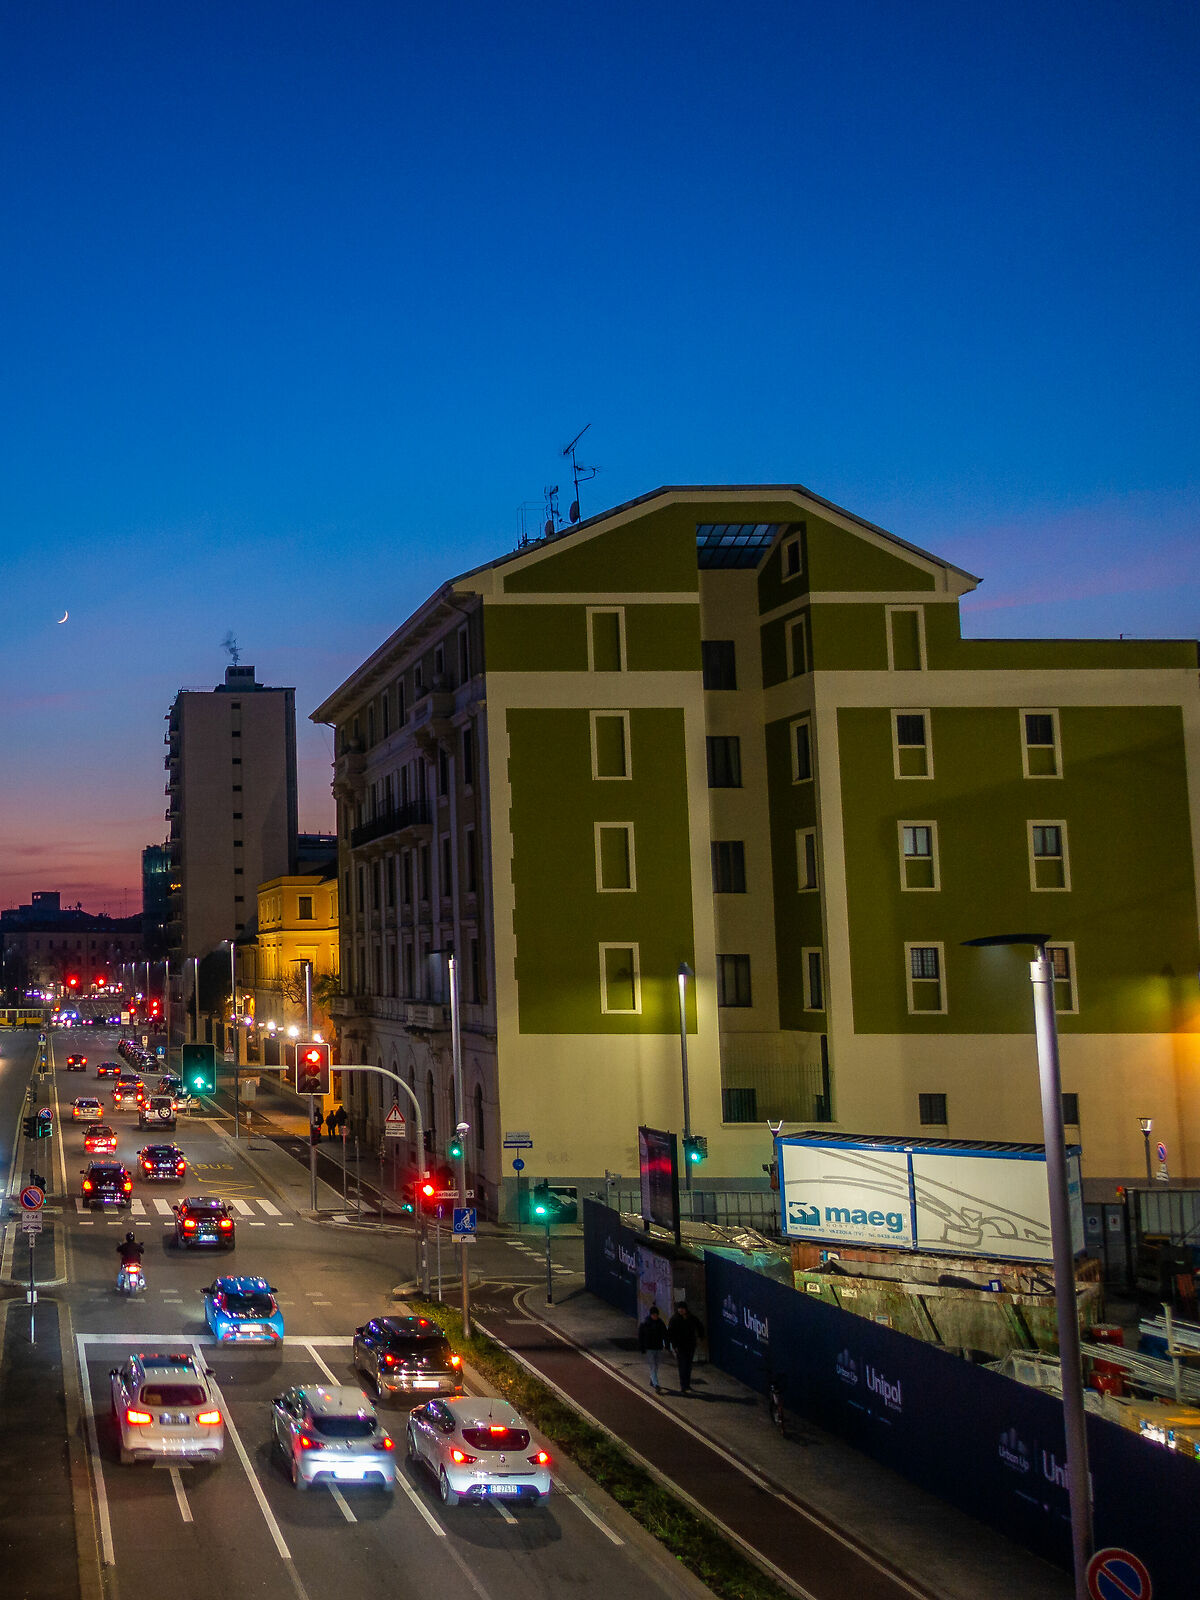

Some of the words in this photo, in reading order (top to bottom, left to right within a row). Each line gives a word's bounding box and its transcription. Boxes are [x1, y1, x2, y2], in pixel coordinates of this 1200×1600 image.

[195, 1163, 234, 1171] BUS
[824, 1206, 903, 1234] maeg
[743, 1306, 769, 1340] Unipol
[866, 1365, 902, 1406] Unipol
